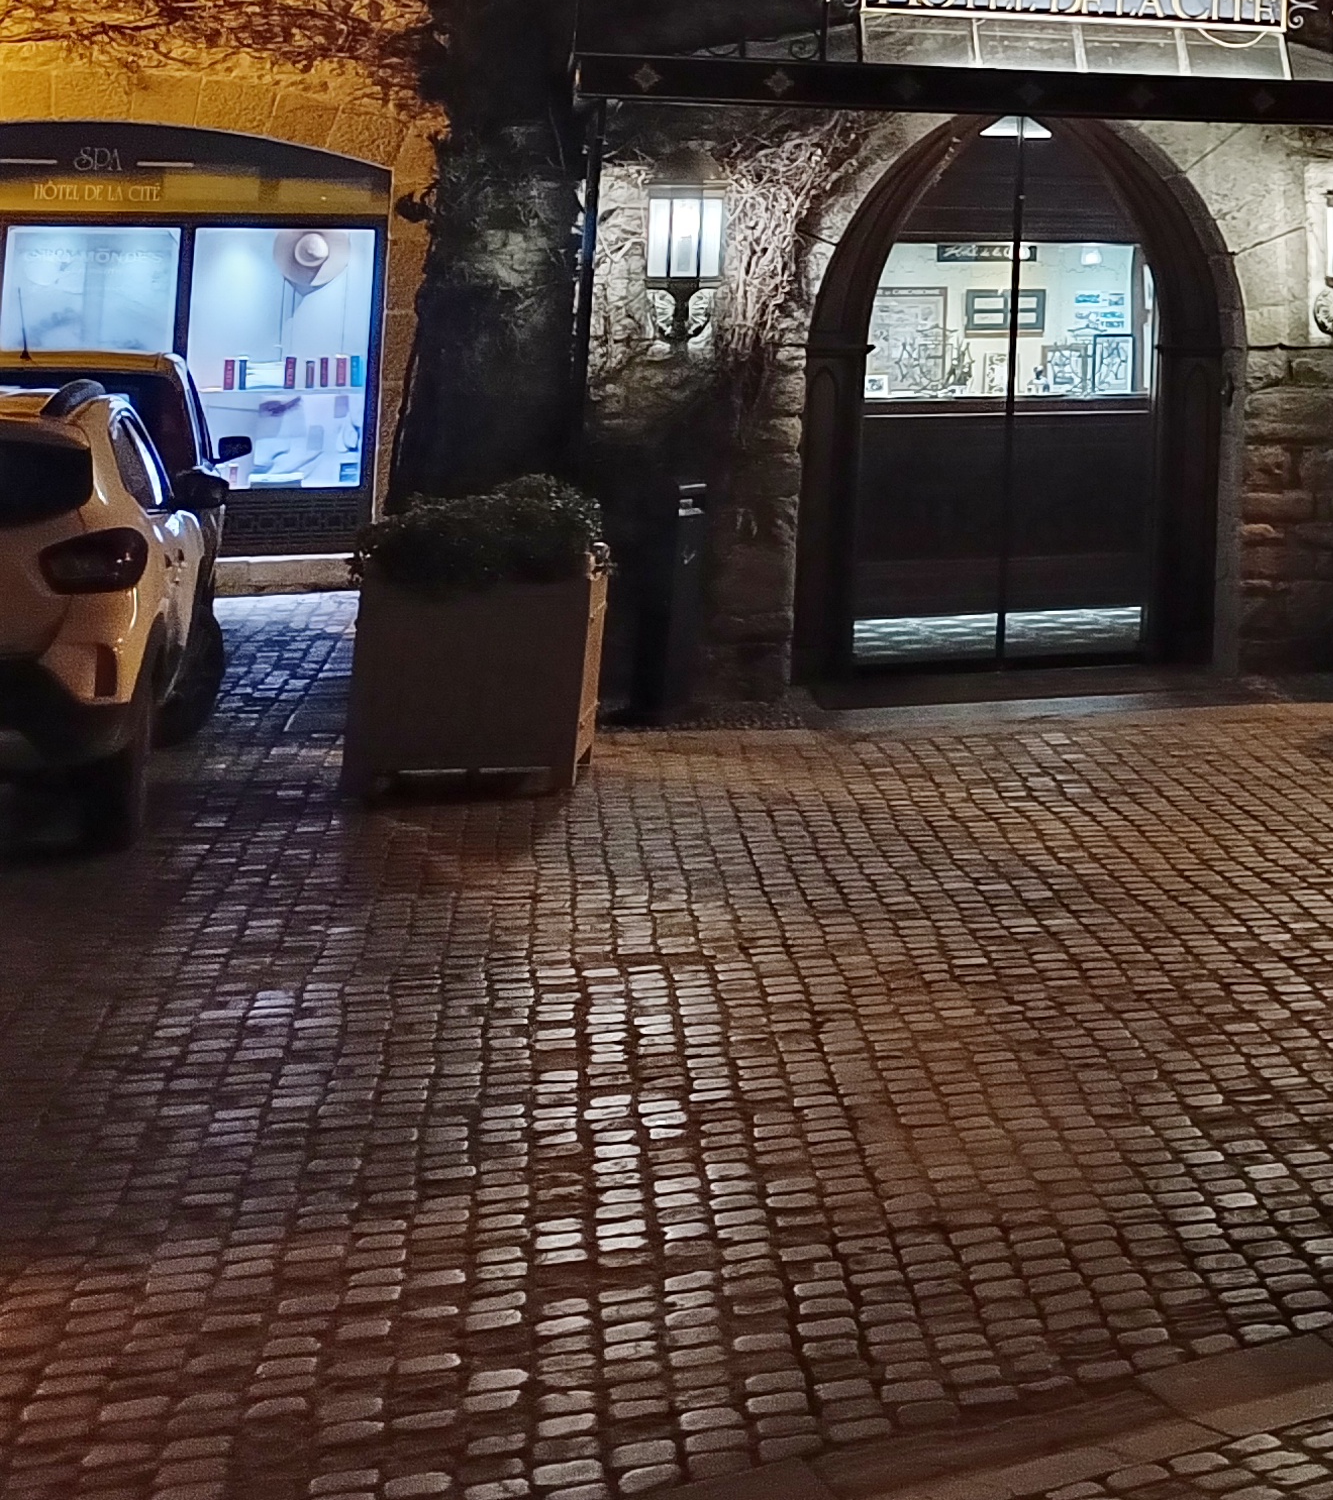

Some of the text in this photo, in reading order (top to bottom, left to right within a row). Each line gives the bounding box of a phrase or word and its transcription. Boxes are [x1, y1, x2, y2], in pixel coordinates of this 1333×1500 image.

[73, 146, 123, 172] SPA
[84, 185, 102, 201] DE
[107, 185, 123, 202] LA
